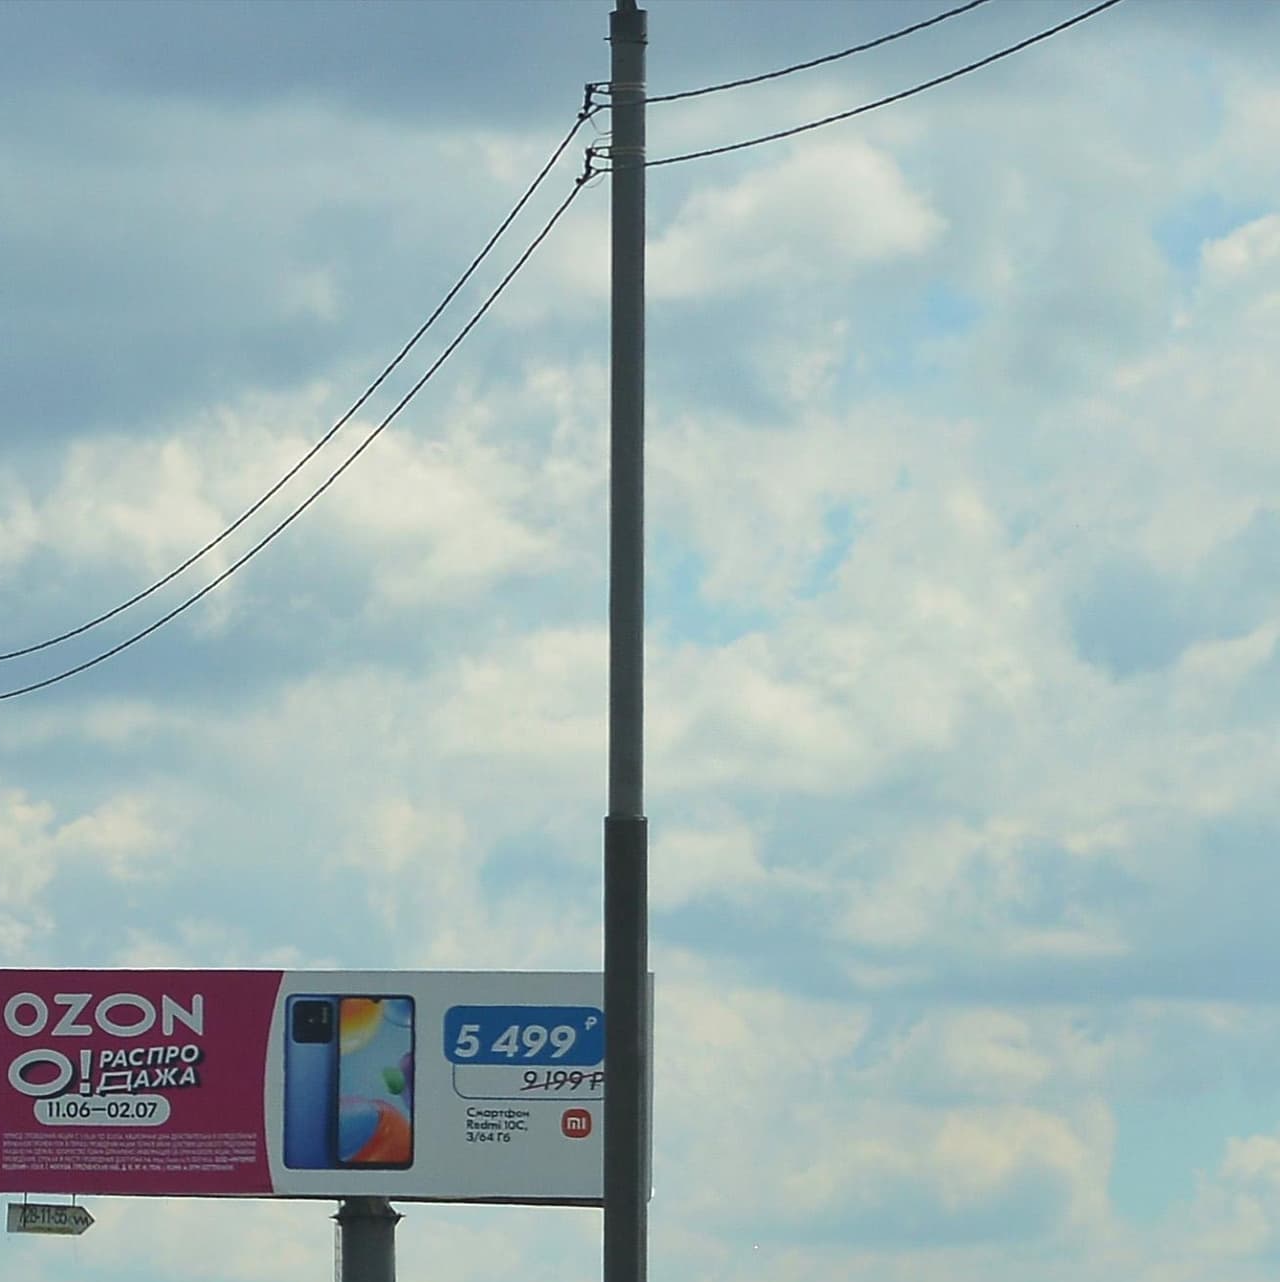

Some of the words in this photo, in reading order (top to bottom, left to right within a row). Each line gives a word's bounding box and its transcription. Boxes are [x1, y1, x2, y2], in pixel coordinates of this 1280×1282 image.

[4, 992, 204, 1037] OZON
[454, 1024, 481, 1058] 5
[491, 1024, 577, 1058] 499
[99, 1044, 200, 1069] РАСПРО
[96, 1066, 197, 1094] ДАЖА
[466, 1107, 530, 1119] Смартфон
[466, 1119, 501, 1130] Redmi
[466, 1131, 494, 1142] 3/64
